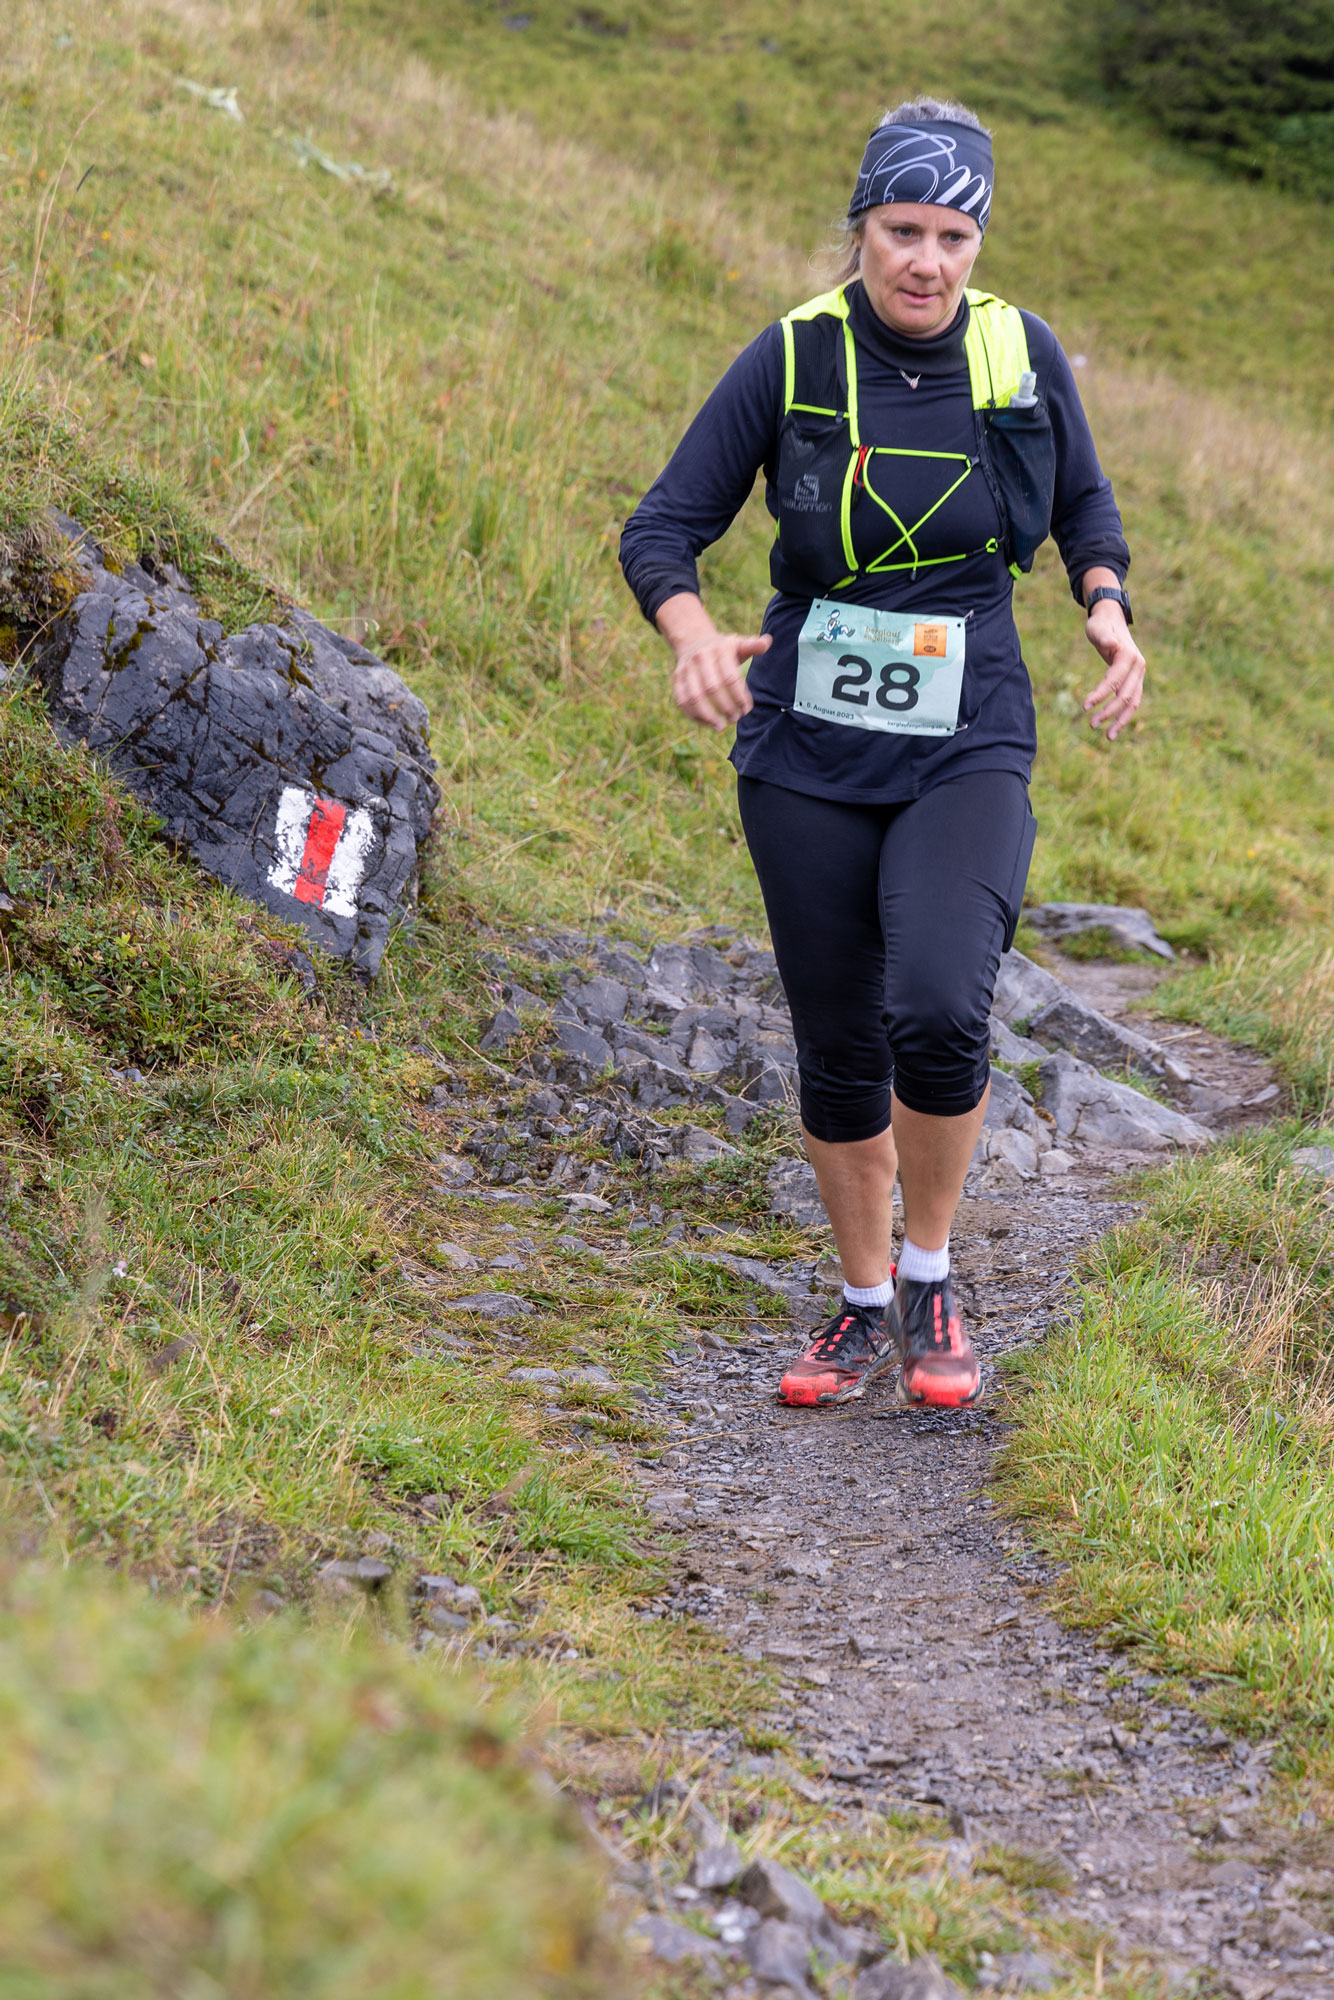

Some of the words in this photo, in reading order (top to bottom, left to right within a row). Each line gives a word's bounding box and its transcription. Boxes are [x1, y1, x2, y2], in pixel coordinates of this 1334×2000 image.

[831, 653, 921, 712] 28
[813, 704, 835, 716] August
[836, 711, 855, 720] 2023
